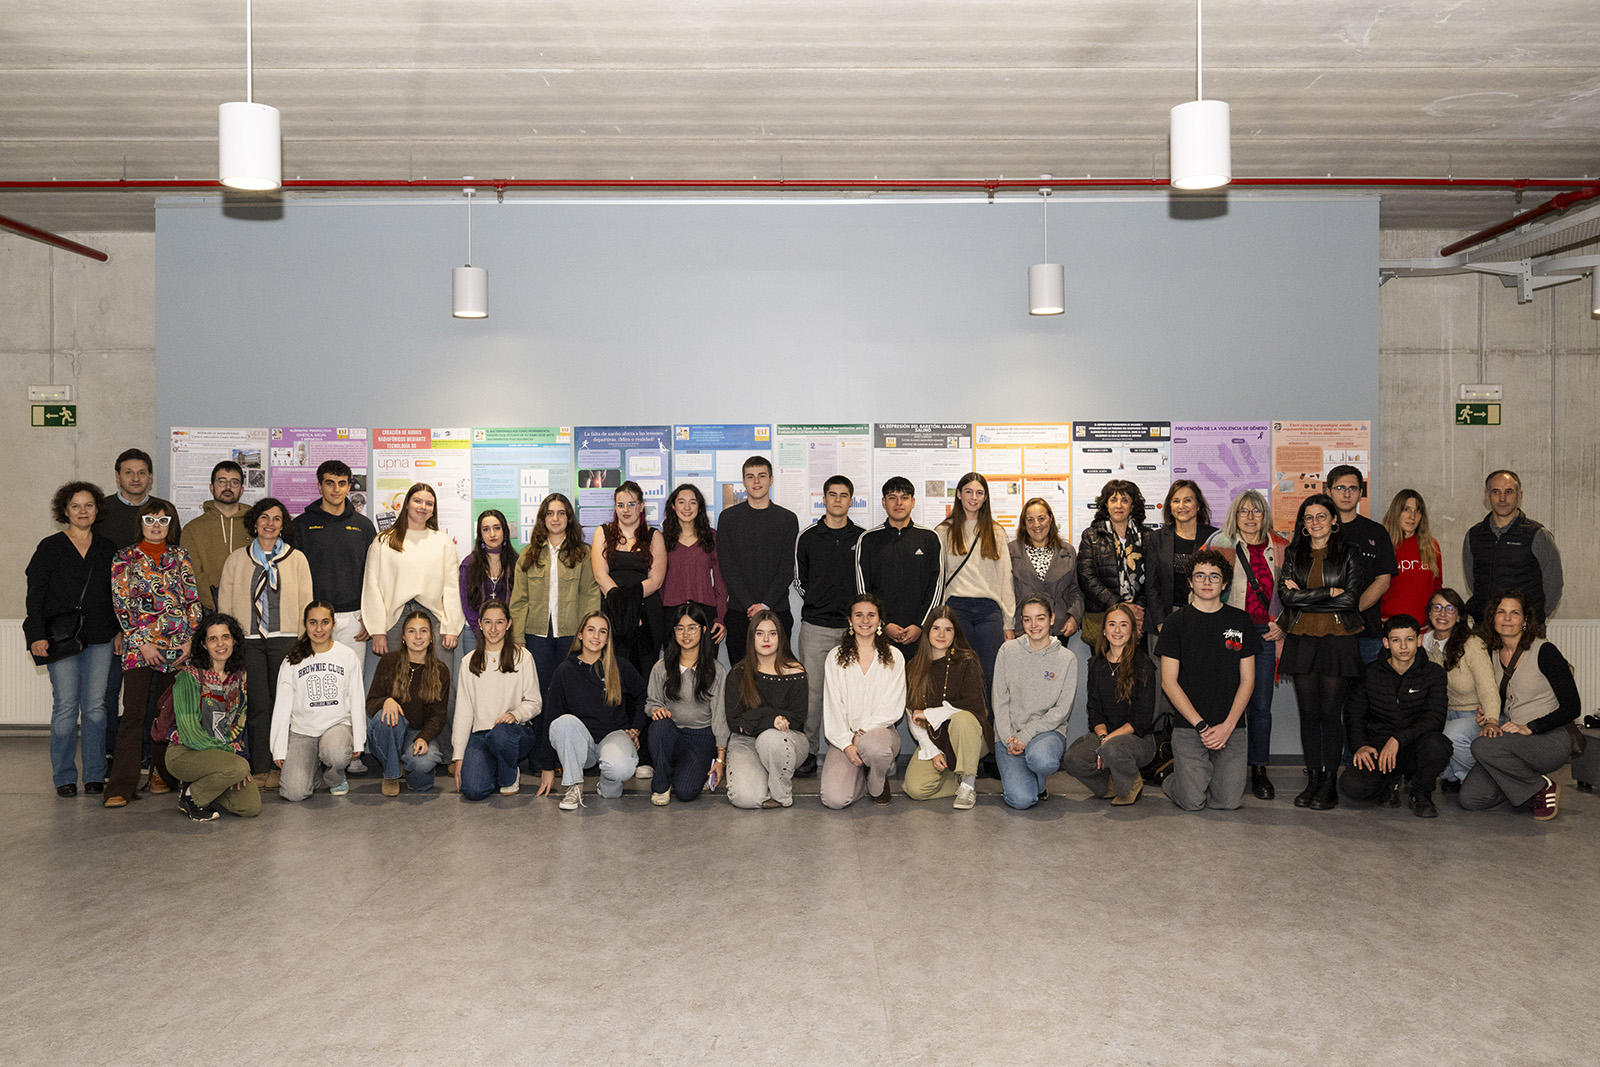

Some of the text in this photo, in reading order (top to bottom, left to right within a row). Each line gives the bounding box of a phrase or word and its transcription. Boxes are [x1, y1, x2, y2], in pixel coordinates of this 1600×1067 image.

[377, 458, 410, 470] upna
[298, 663, 345, 679] BROWNIE CLUB
[306, 673, 339, 701] 06
